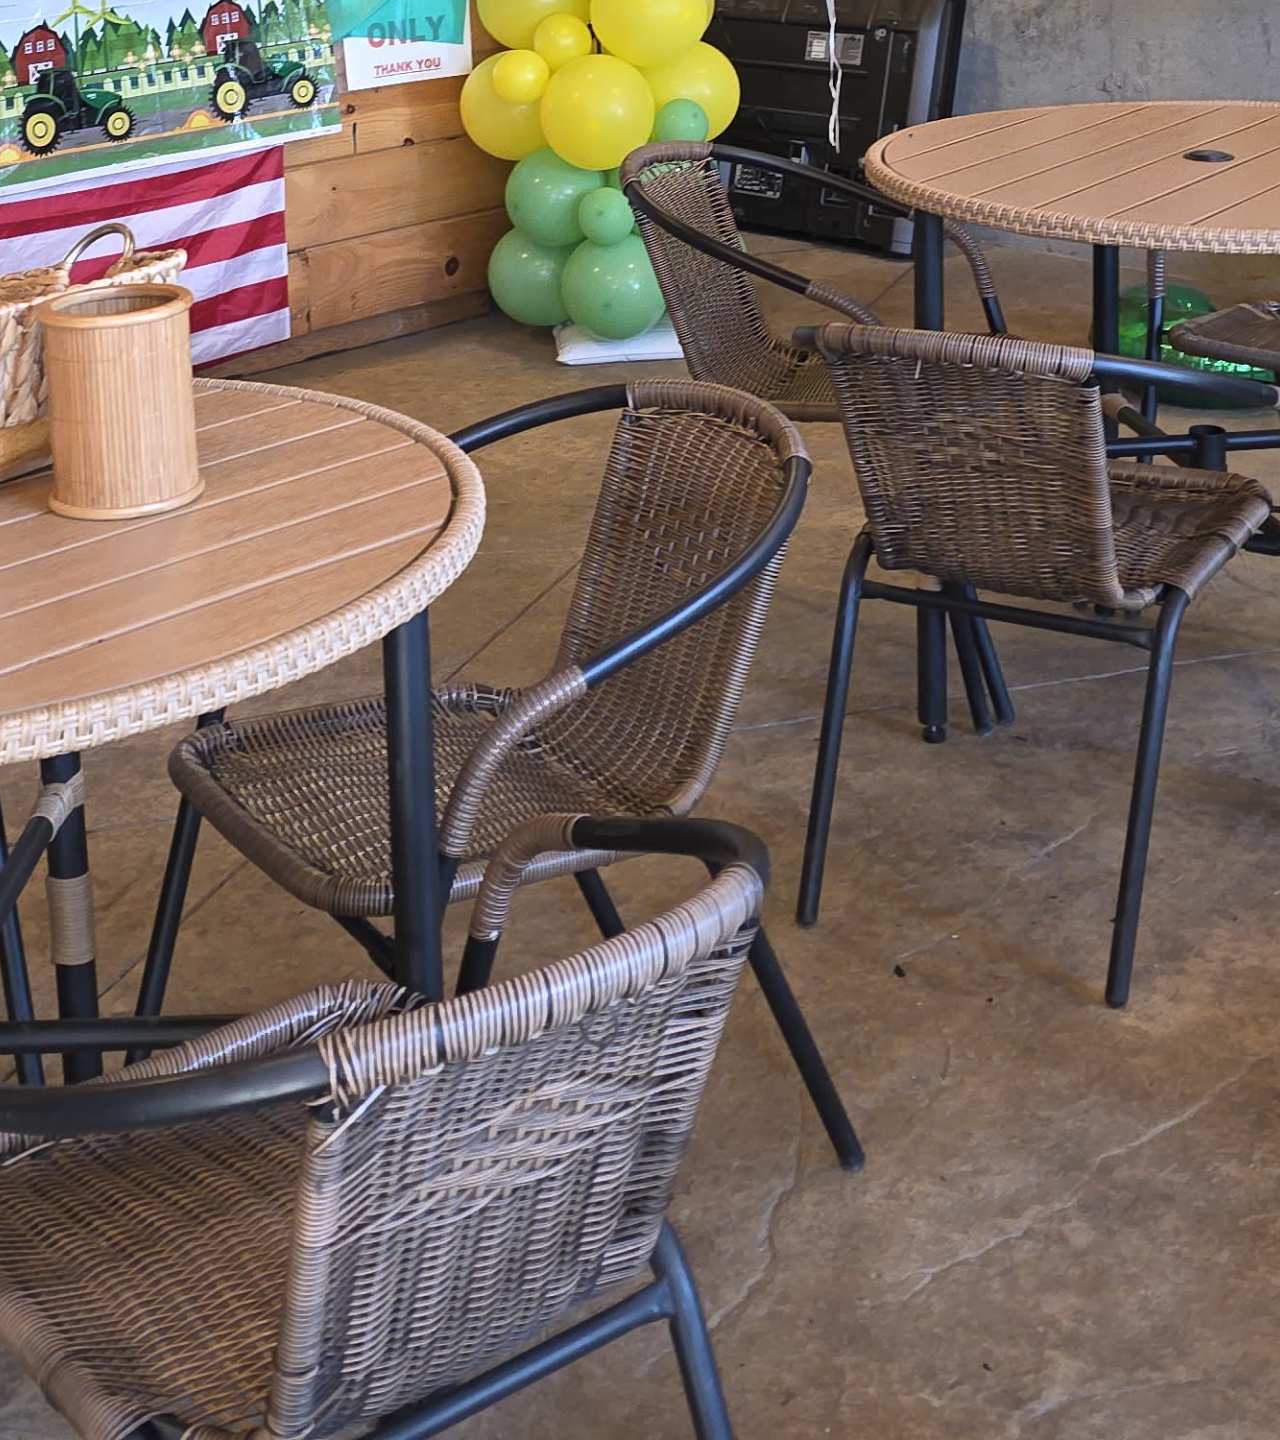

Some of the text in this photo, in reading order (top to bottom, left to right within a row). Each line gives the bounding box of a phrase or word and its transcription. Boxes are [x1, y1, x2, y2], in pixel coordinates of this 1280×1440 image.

[367, 14, 446, 49] ONLY
[373, 57, 442, 77] THANK YOU
